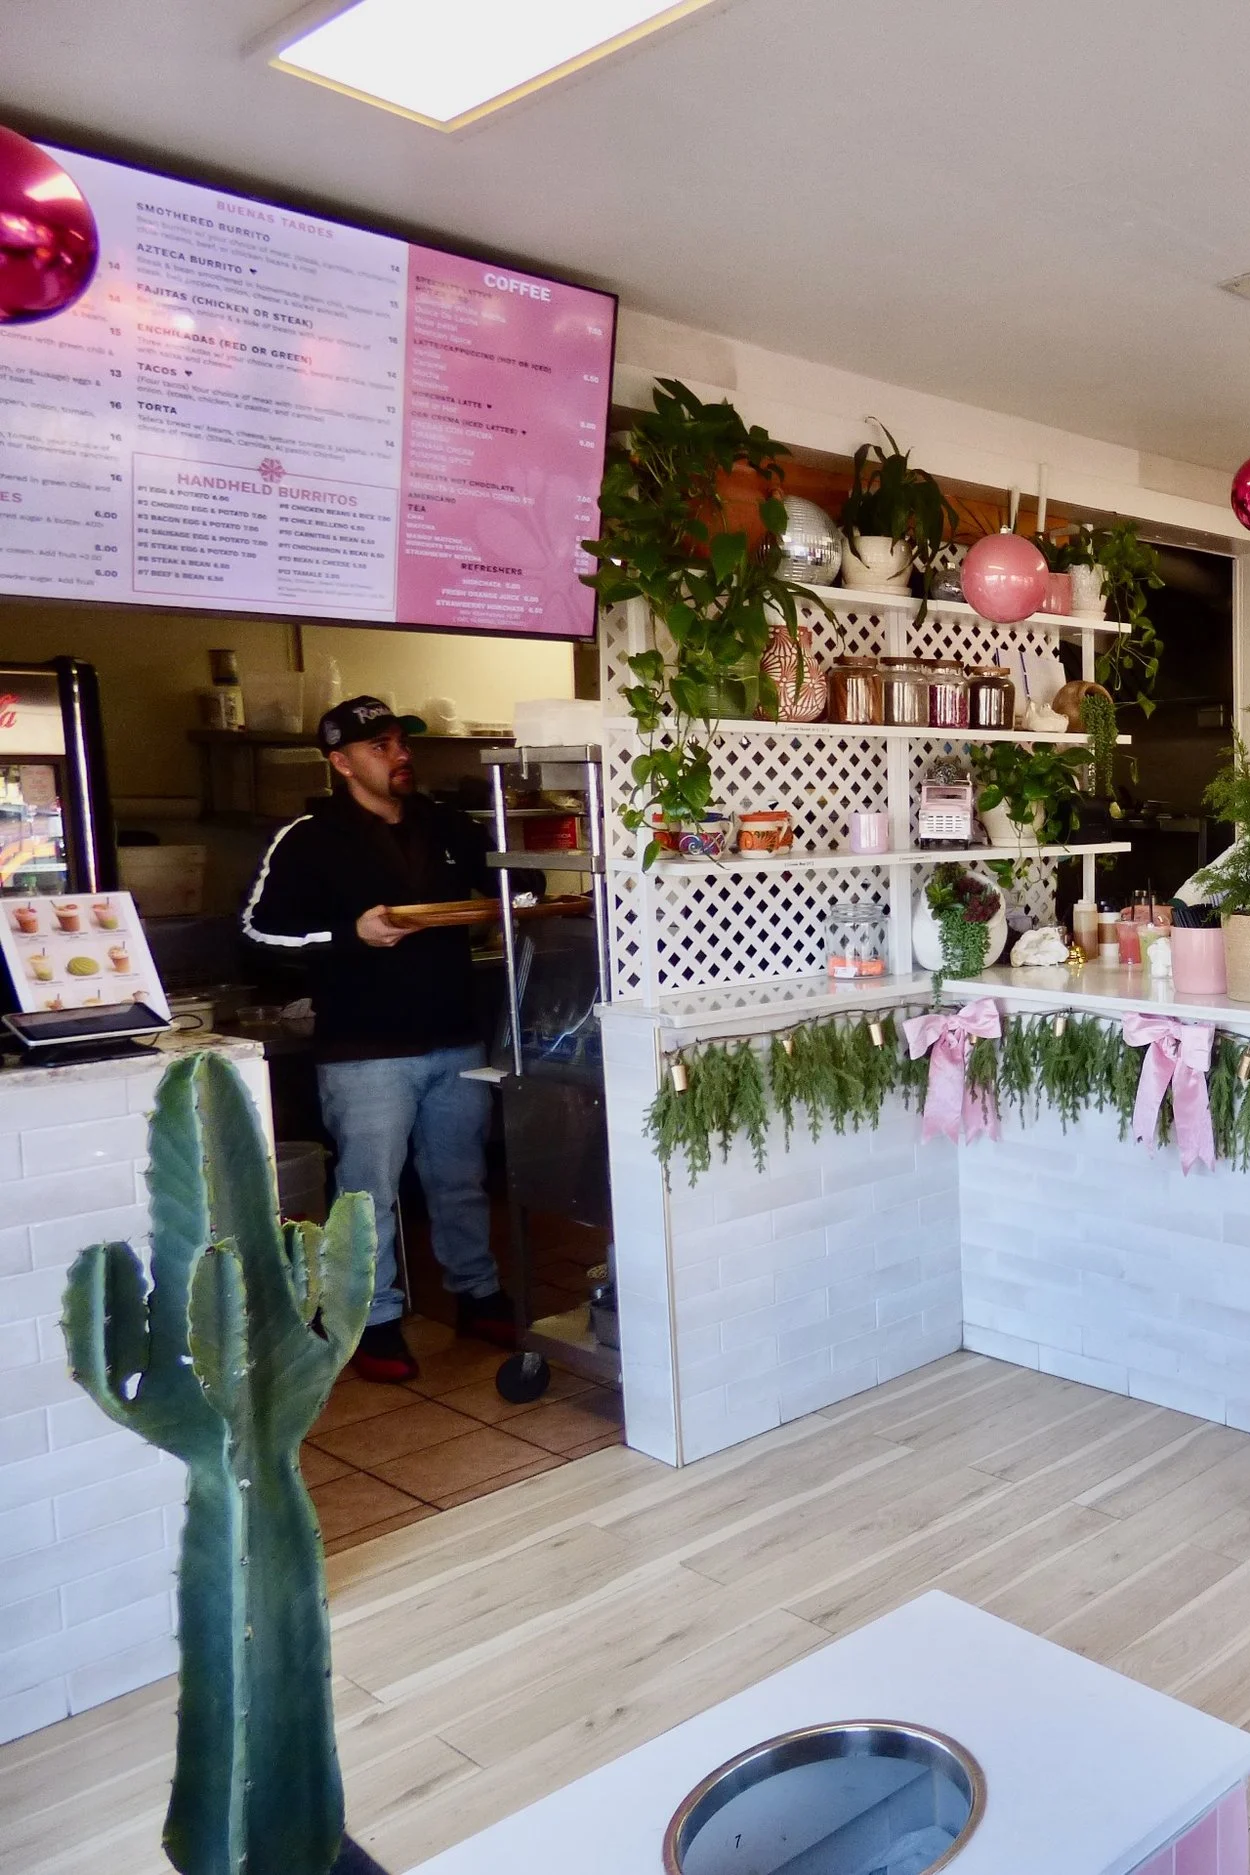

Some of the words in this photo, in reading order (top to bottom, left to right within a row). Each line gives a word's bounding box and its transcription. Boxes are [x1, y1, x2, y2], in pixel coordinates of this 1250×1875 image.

[136, 202, 214, 228] SMOTHERED
[218, 223, 270, 242] BURRITO
[217, 200, 275, 223] BUENAS
[281, 217, 334, 239] TARDES
[137, 243, 186, 261] AZTECA
[190, 255, 242, 274] BURRITO
[108, 261, 120, 270] 14
[484, 272, 552, 302] COFFEE
[136, 283, 188, 301] FAJITAS
[192, 296, 249, 314] (CHICKEN
[253, 309, 269, 318] OR
[273, 313, 313, 329] STEAK)
[109, 327, 121, 336] 15
[137, 323, 215, 346] ENCHILADAS
[219, 339, 248, 352] (RED
[251, 346, 267, 355] OR
[271, 350, 312, 365] GREEN)
[110, 369, 122, 378] 13
[136, 362, 177, 376] TACOS
[110, 401, 122, 410] 16
[137, 400, 178, 415] TORTA
[458, 399, 483, 409] LATTE
[110, 433, 122, 441] 16
[385, 439, 395, 448] 14
[110, 474, 122, 482] 16
[177, 473, 272, 495] HANDHELD
[279, 486, 358, 507] BURRITOS
[468, 480, 515, 493] CHOCOLATE
[177, 490, 209, 500] POTATO
[191, 505, 208, 514] EGG
[218, 508, 249, 518] POTATO
[291, 504, 324, 514] CHICKEN
[408, 503, 426, 513] TEA
[94, 510, 118, 519] 6.00
[151, 514, 180, 524] BACON
[182, 518, 200, 526] EGG
[209, 521, 241, 531] POTATO
[192, 533, 209, 541] EGG
[219, 536, 250, 546] POTATO
[94, 544, 118, 553] 8.00
[151, 542, 178, 551] STEAK
[180, 545, 198, 554] EGG
[207, 548, 239, 557] POTATO
[151, 556, 179, 565] STEAK
[188, 559, 211, 568] BEAN
[94, 569, 118, 578] 6.00
[460, 562, 523, 576] REFRESHERS
[182, 573, 205, 581] BEAN
